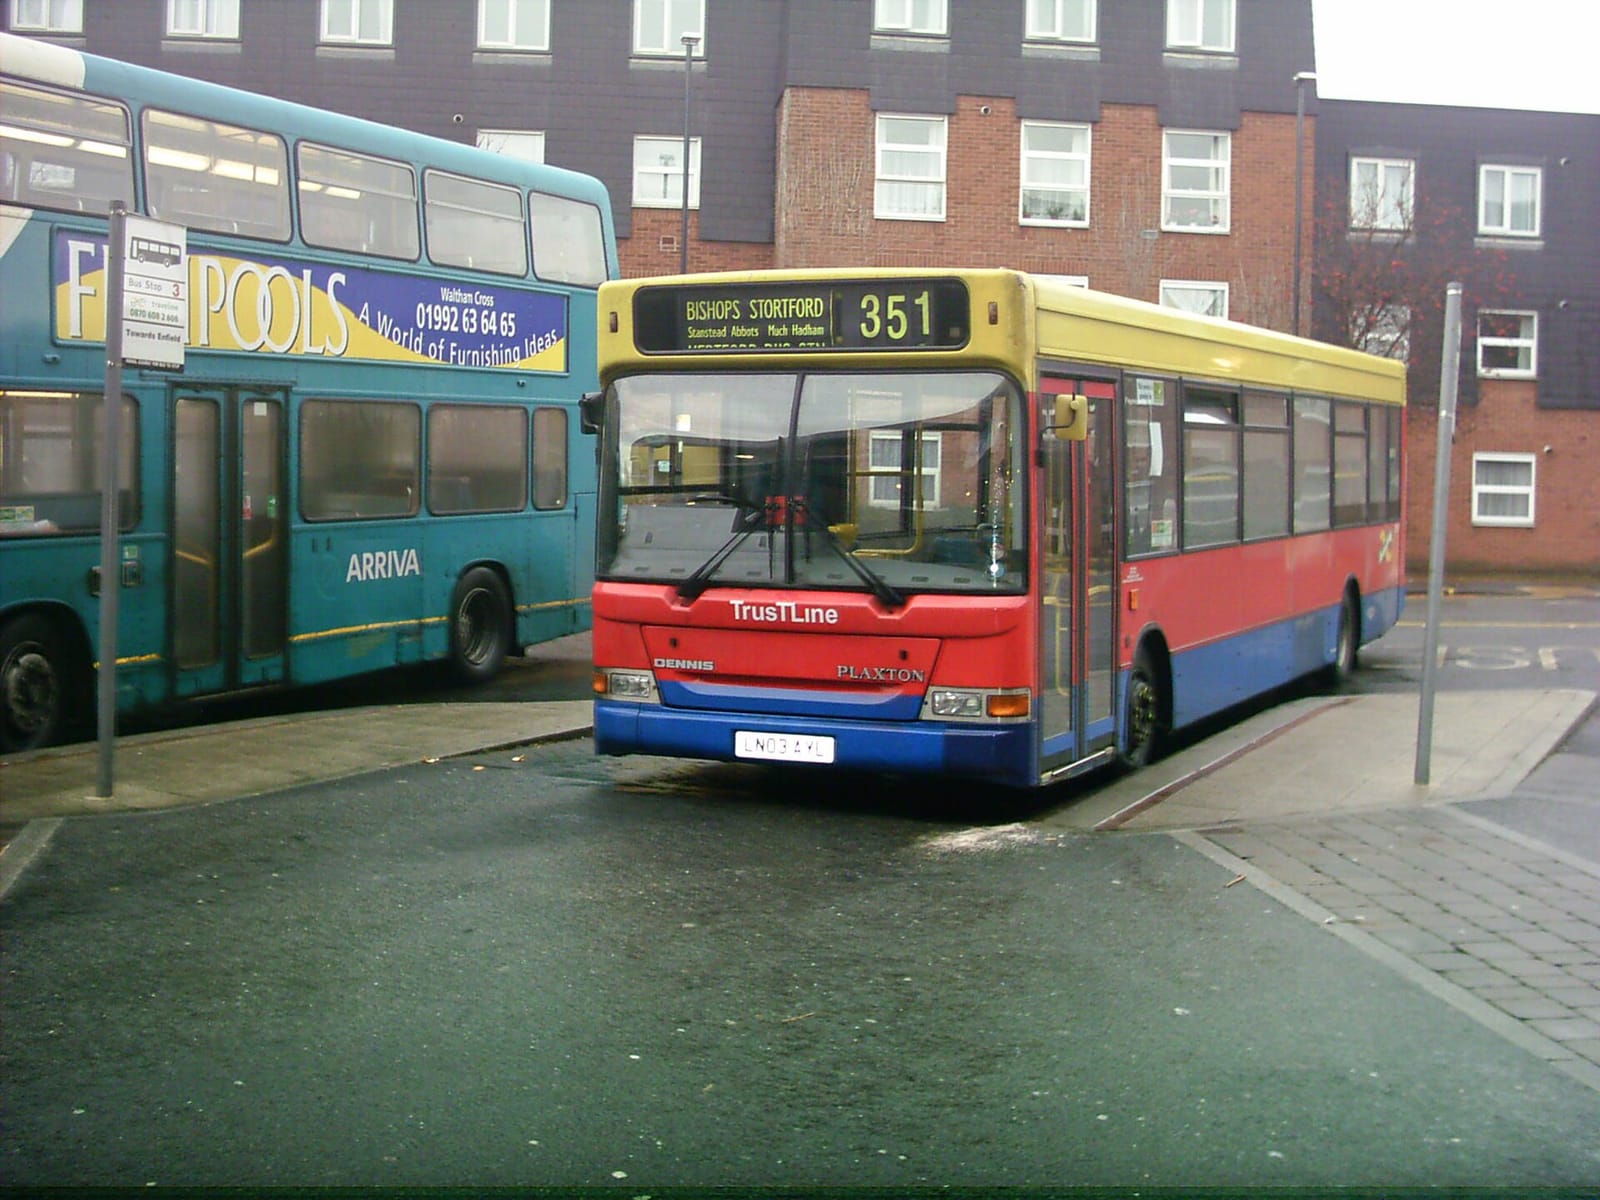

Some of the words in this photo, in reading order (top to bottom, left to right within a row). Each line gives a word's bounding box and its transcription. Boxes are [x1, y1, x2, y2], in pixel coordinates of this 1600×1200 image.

[128, 277, 142, 288] Bus
[144, 280, 163, 292] Stop
[172, 283, 181, 297] 3
[68, 239, 349, 358] FPOOLS
[440, 286, 473, 305] Waltham
[475, 291, 495, 307] Cross
[416, 302, 460, 333] 01992
[462, 308, 477, 334] 63
[481, 310, 498, 336] 64
[500, 312, 516, 338] 65
[686, 300, 741, 321] BISHOPS
[749, 297, 824, 319] STORTFORD
[860, 290, 930, 339] 351
[125, 328, 156, 341] Towards
[157, 331, 181, 343] Enfield
[359, 301, 371, 328] A
[377, 310, 424, 355] World
[428, 338, 445, 362] of
[449, 340, 521, 368] Furnishing
[524, 328, 558, 357] Ideas
[687, 325, 727, 338] Stanstead
[731, 325, 760, 337] Abbots
[767, 323, 788, 337] Much
[791, 323, 825, 336] Hadham
[345, 548, 421, 583] ARRIVA
[729, 599, 839, 625] TrusTLine
[653, 657, 715, 672] DENNIS
[836, 664, 926, 683] PLAXTON
